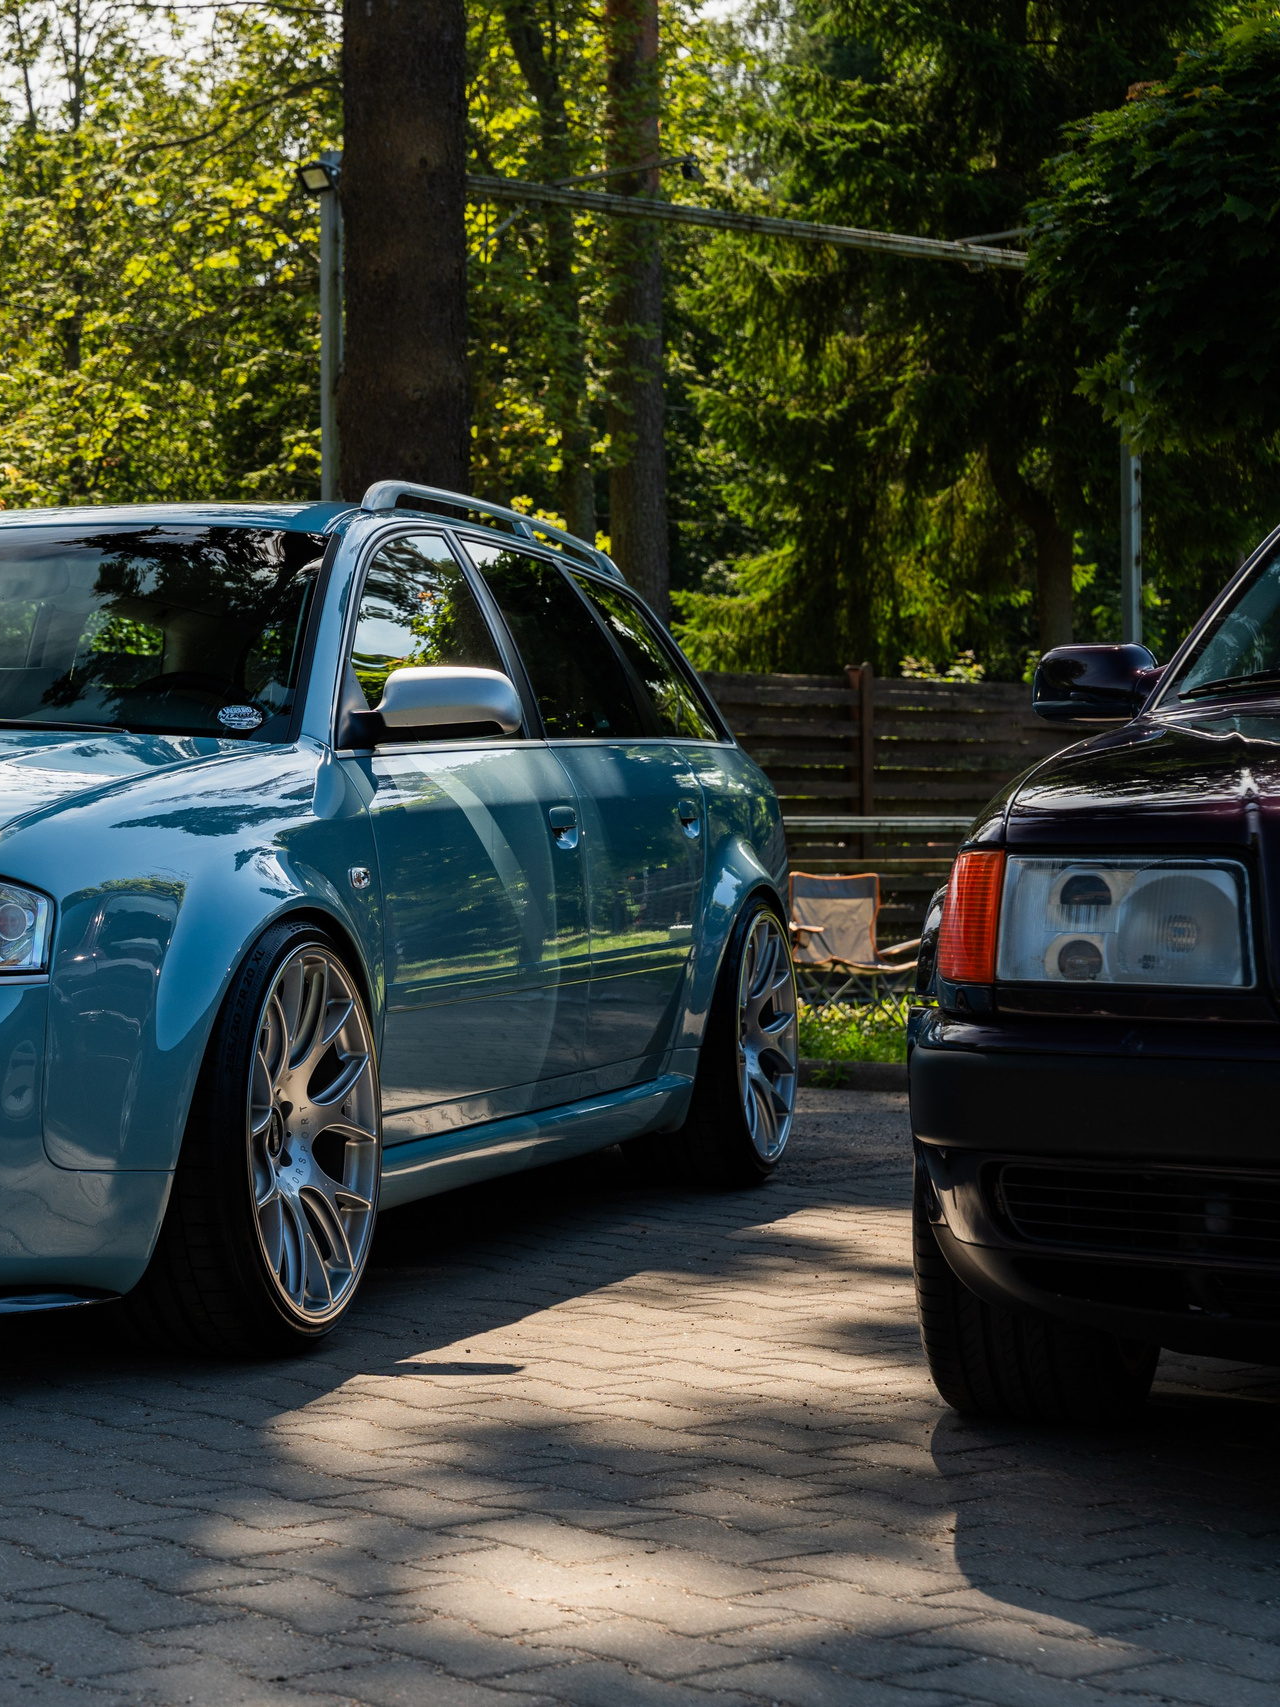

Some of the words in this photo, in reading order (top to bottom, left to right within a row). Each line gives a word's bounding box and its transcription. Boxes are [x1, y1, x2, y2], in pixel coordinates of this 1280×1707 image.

[235, 988, 250, 1011] ZR
[244, 967, 257, 987] 20
[251, 949, 266, 966] XL
